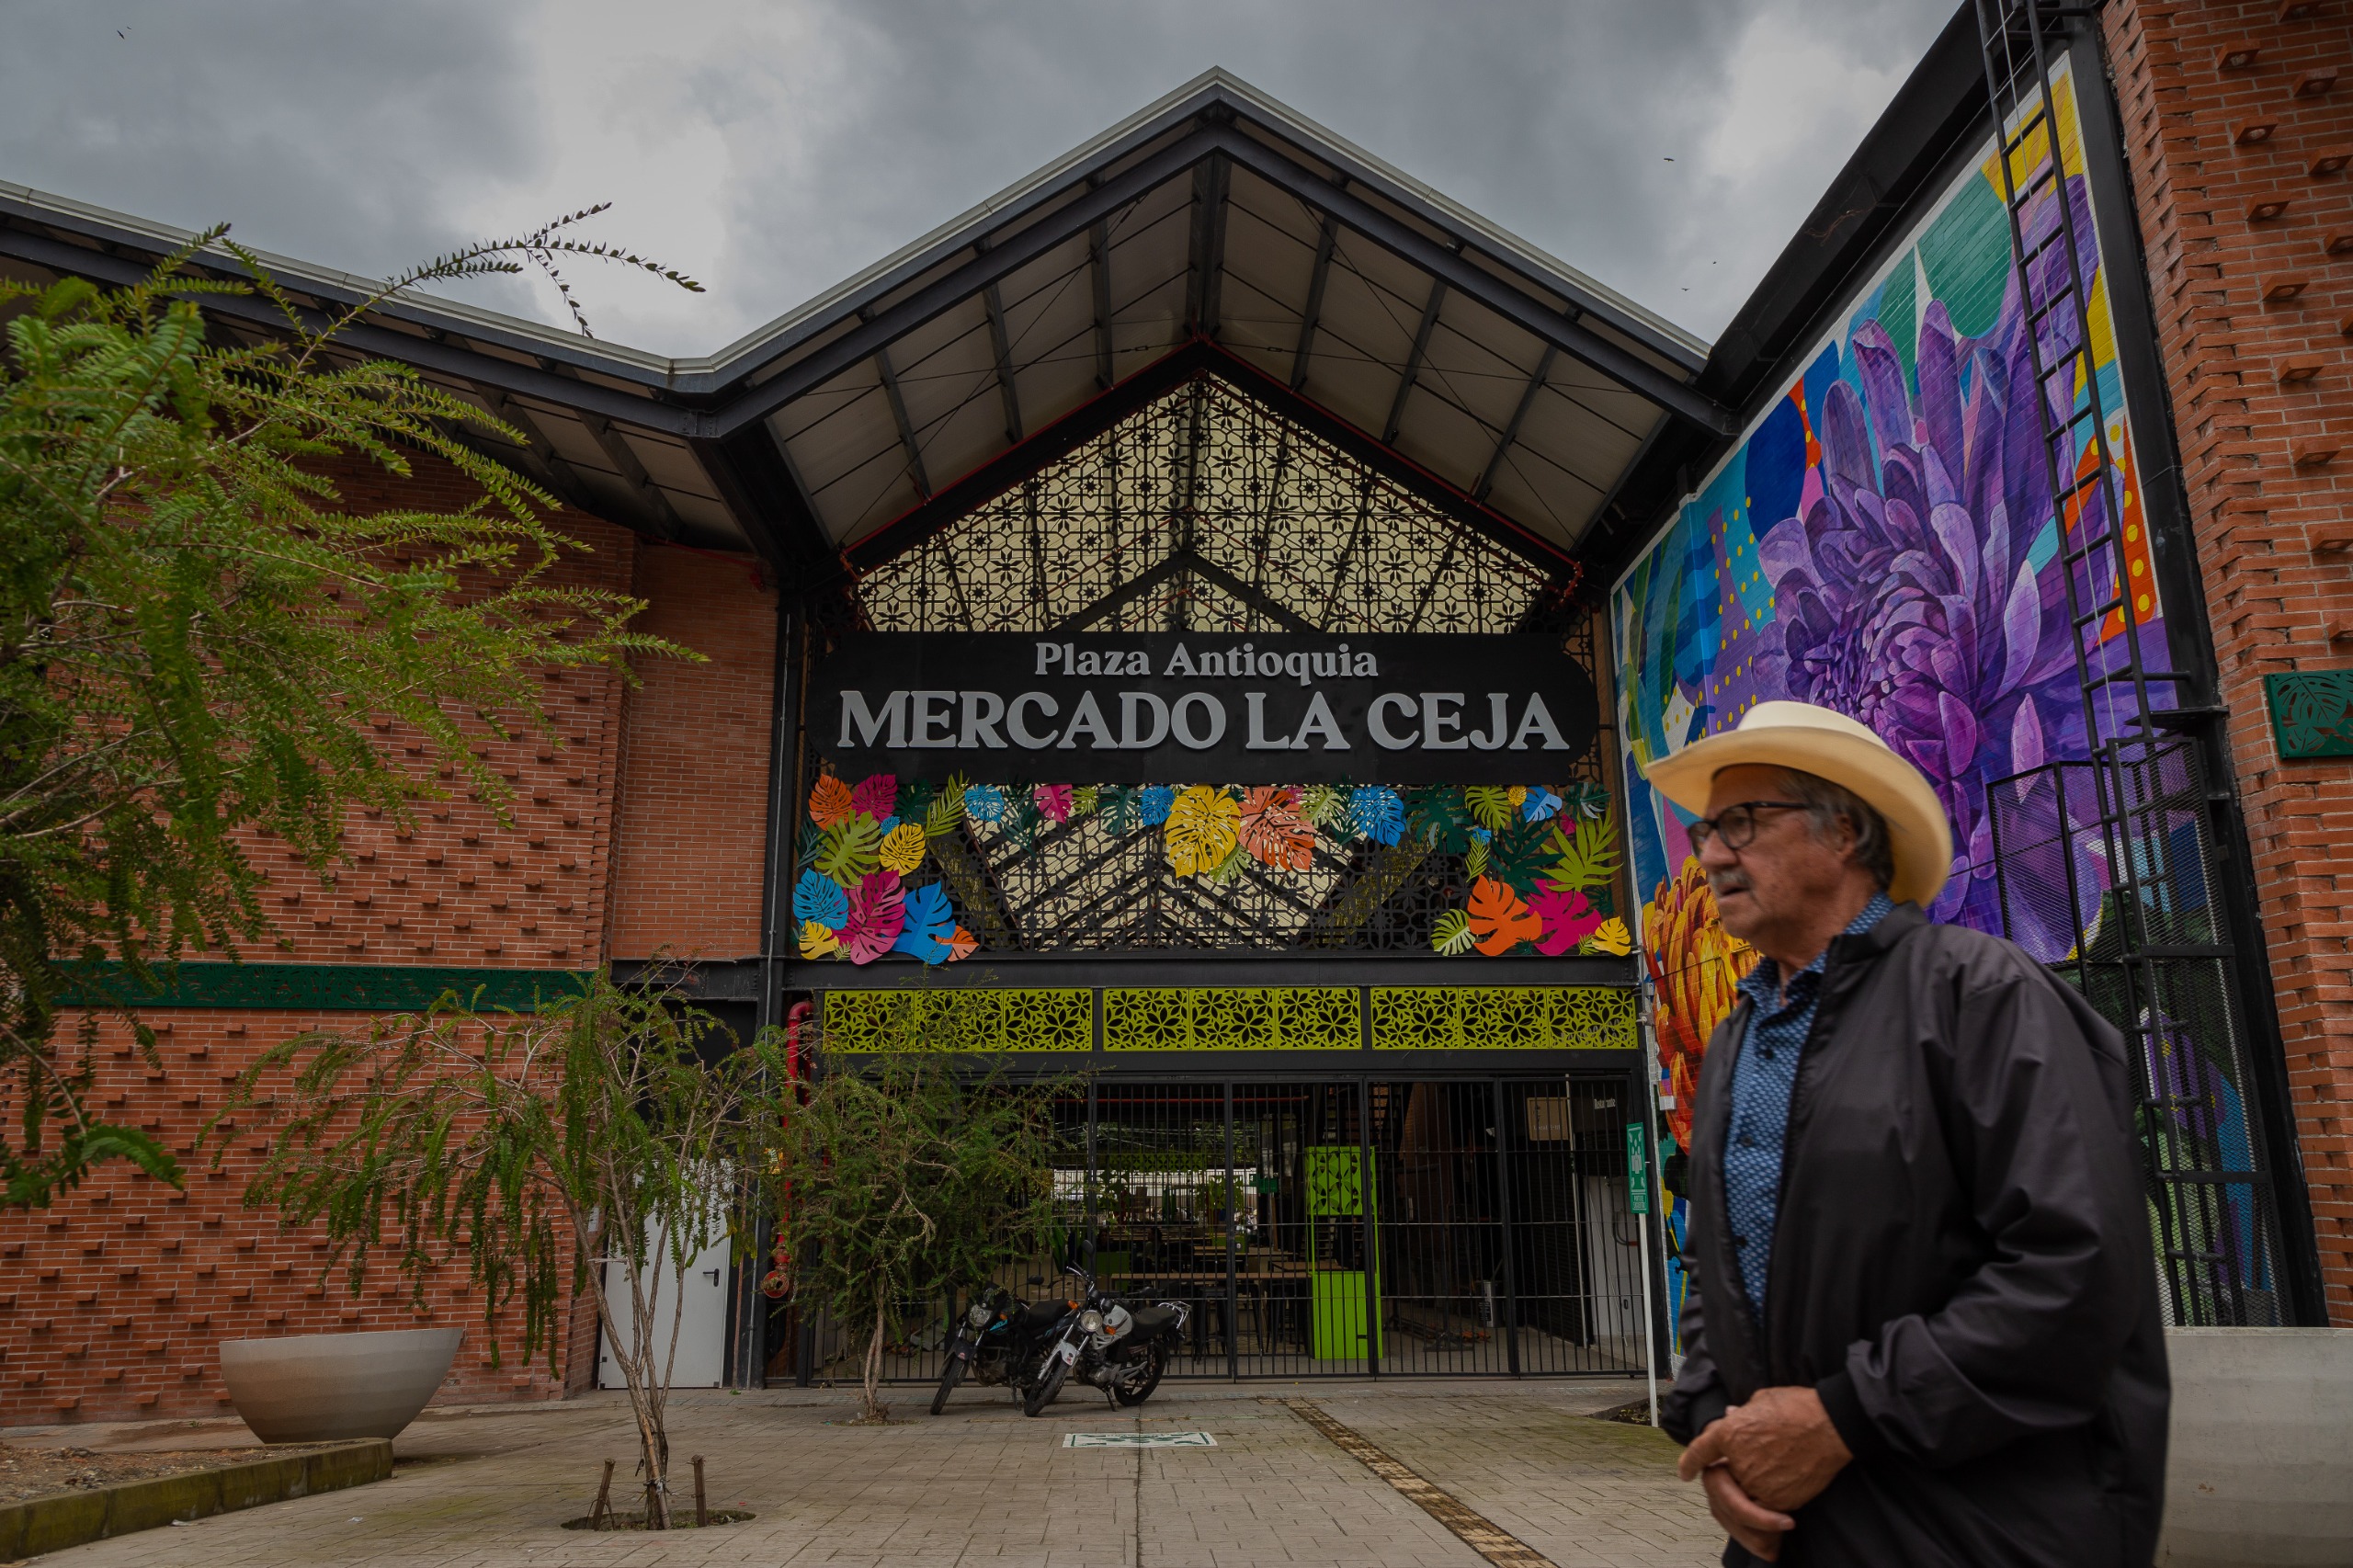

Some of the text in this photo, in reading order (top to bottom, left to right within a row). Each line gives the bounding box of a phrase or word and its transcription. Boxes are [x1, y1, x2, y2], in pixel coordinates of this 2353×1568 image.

[1034, 642, 1379, 687] Plaza Antioquia
[836, 689, 1570, 750] MERCADO LA CEJA
